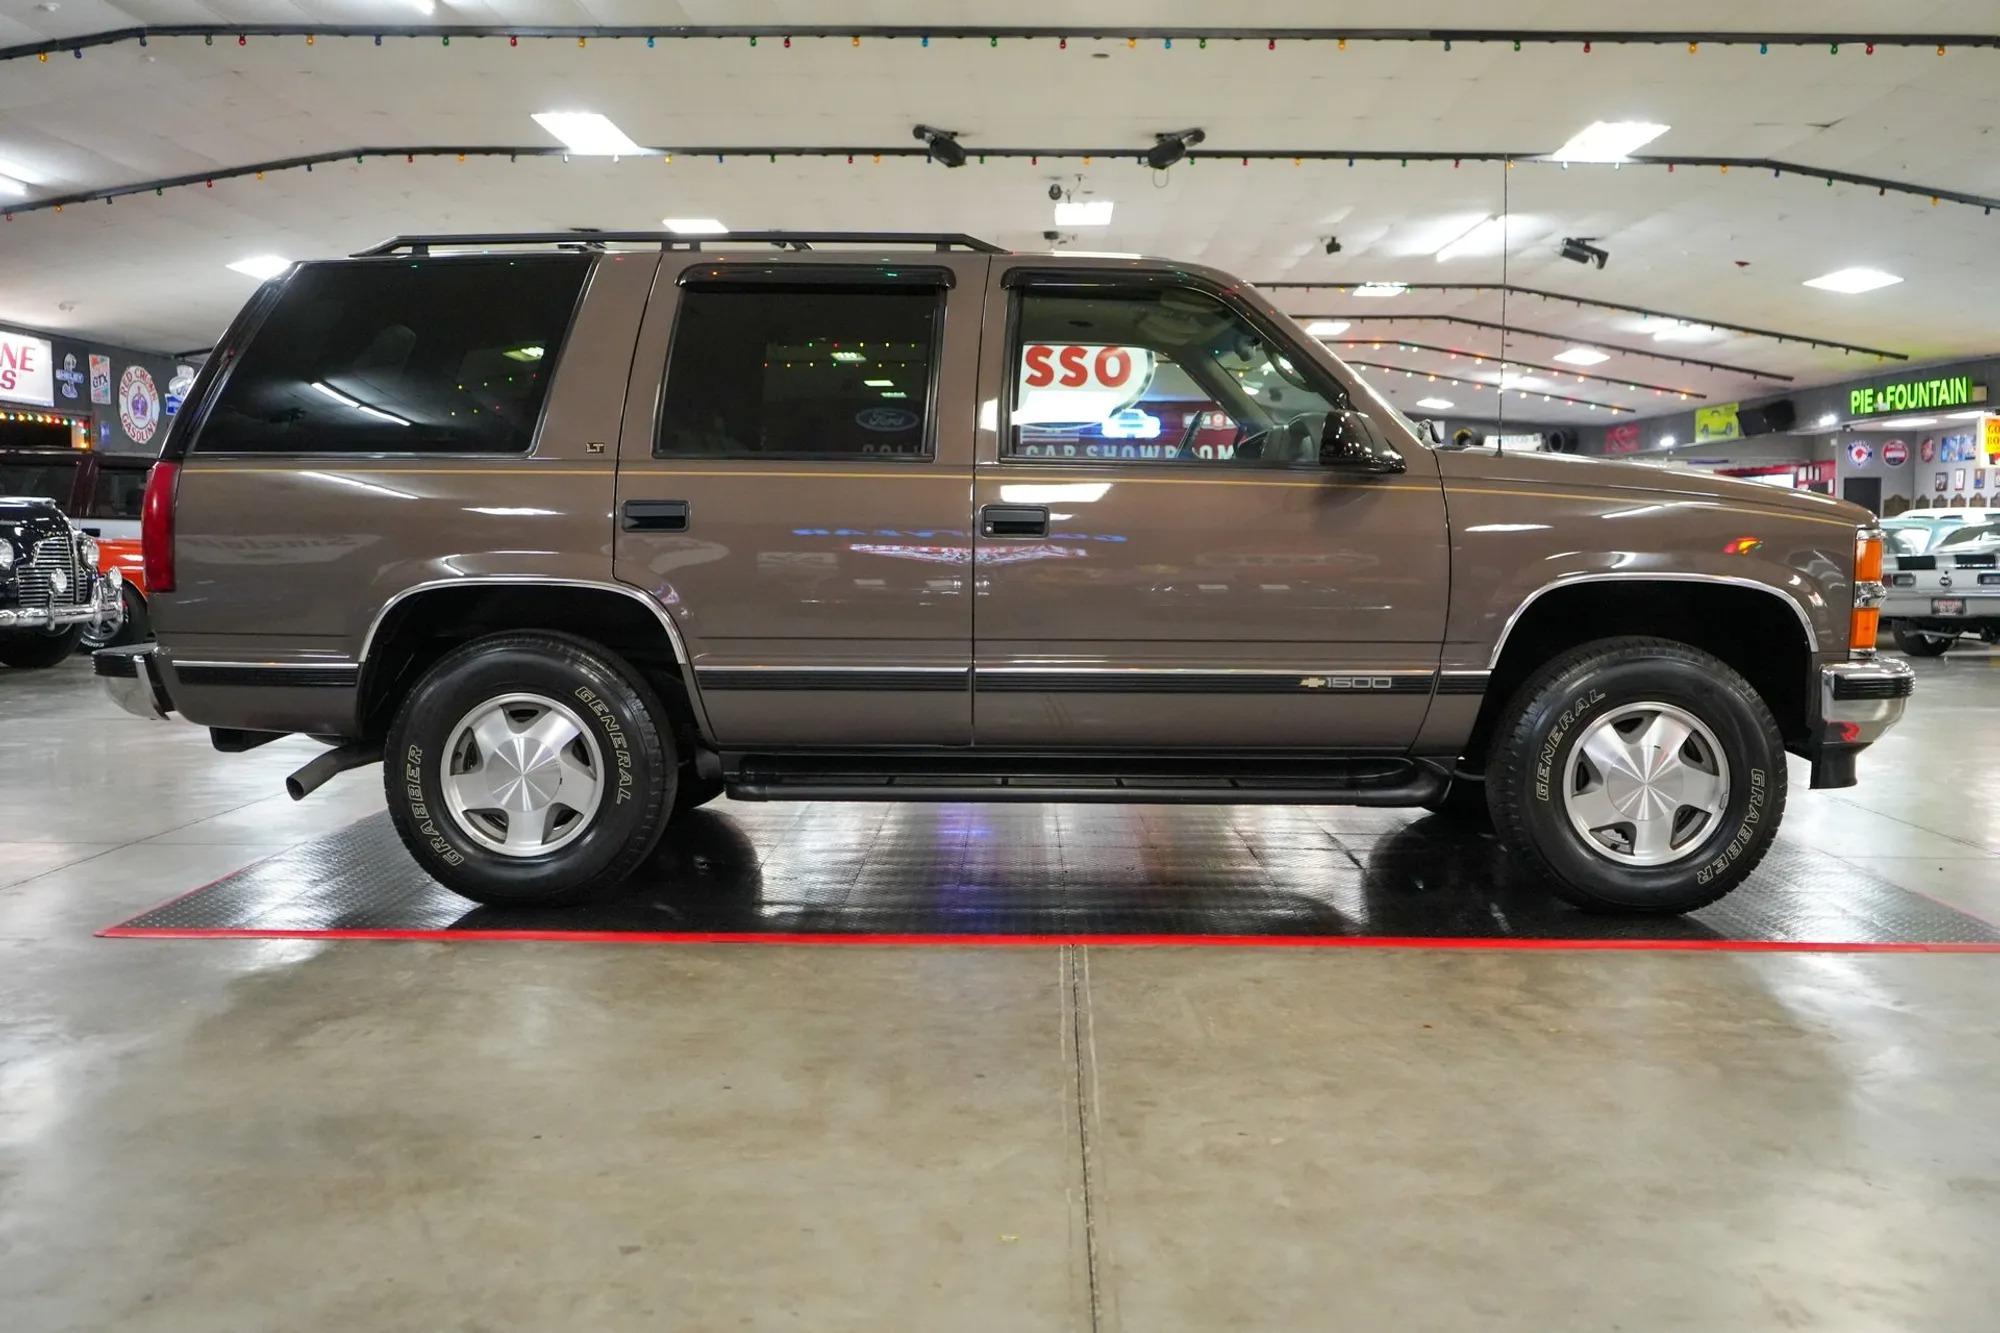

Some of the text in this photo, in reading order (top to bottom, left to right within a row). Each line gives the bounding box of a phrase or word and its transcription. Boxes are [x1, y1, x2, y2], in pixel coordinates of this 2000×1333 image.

[586, 443, 604, 453] LT
[1851, 377, 1967, 415] PIE FOUNTAIN
[1326, 676, 1392, 688] 1500
[575, 686, 633, 805] GENERAL
[1536, 689, 1606, 801] GENERAL
[406, 745, 464, 866] GRABBER
[1697, 768, 1765, 884] GRABBER
